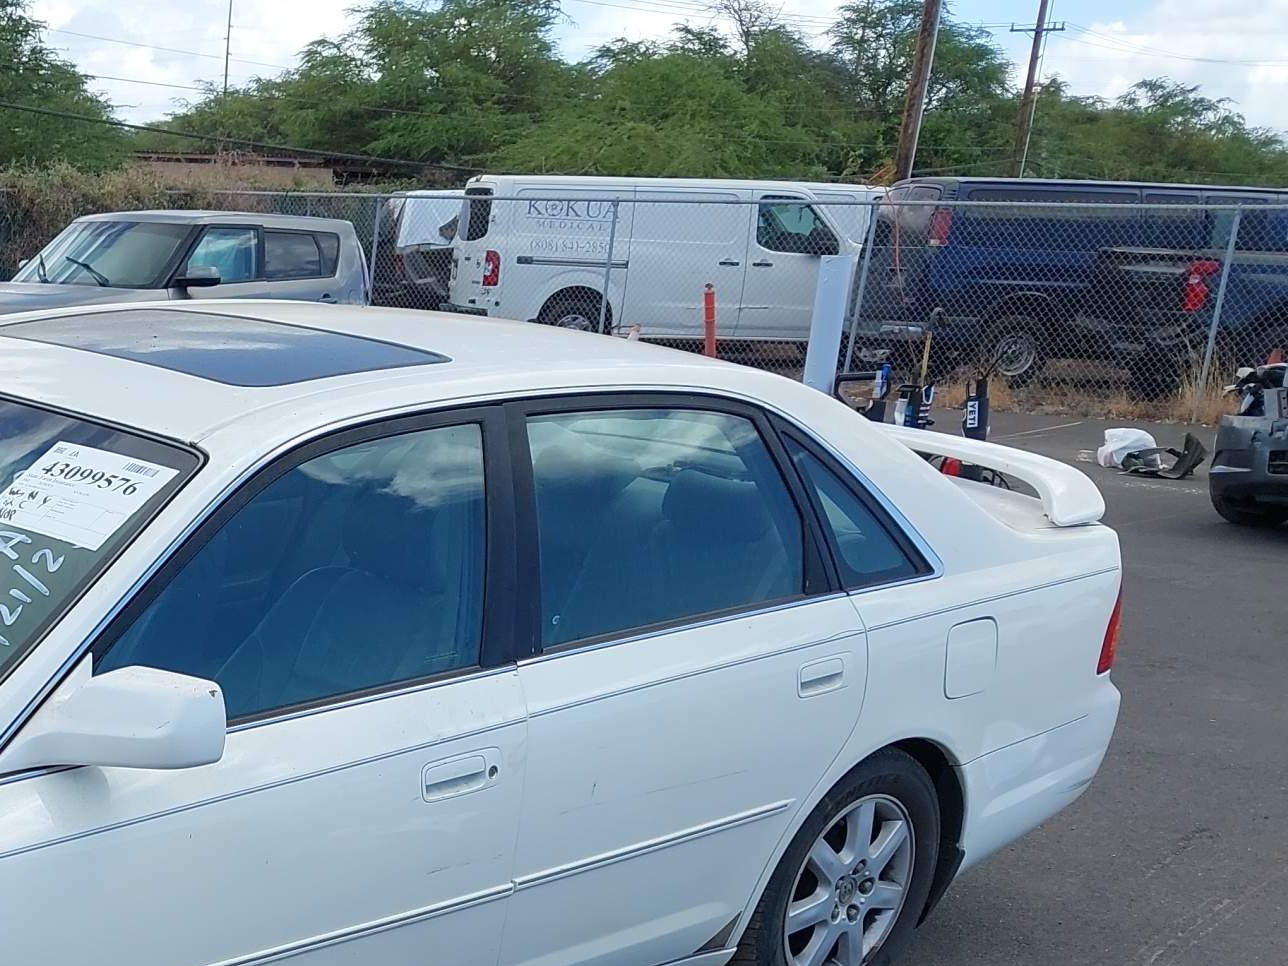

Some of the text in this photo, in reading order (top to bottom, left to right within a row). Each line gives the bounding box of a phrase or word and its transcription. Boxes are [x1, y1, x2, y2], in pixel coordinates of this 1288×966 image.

[526, 199, 620, 219] KOKUA
[967, 402, 978, 426] YETI
[41, 461, 142, 496] 43099576
